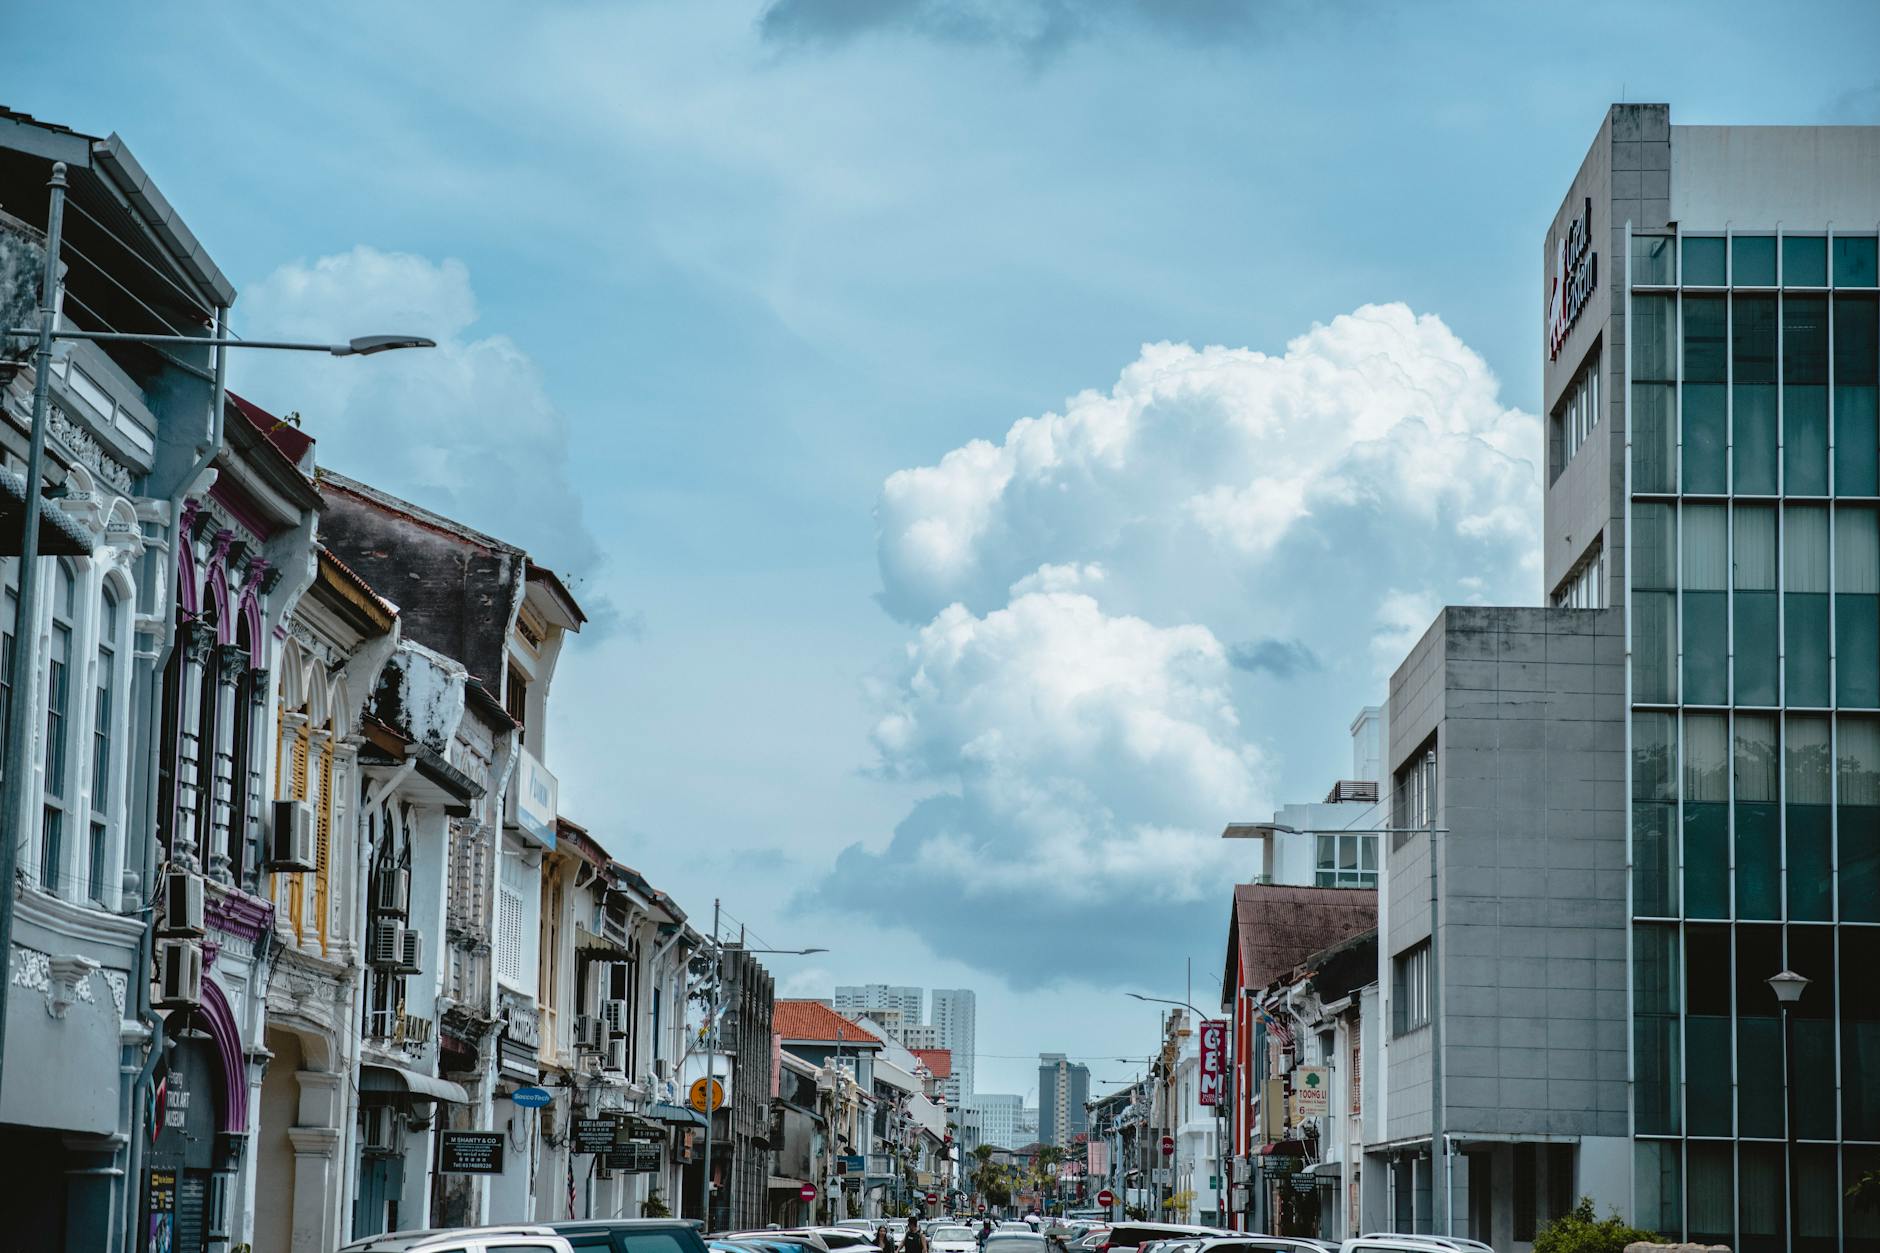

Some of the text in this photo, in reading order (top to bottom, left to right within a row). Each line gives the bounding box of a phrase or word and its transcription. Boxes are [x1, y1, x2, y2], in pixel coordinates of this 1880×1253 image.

[1566, 197, 1591, 273] Great
[1565, 251, 1597, 330] Eastern
[1201, 1028, 1224, 1094] GEM
[167, 1091, 190, 1108] TRICK ART
[1299, 1089, 1327, 1099] TOONG LI
[165, 1110, 185, 1127] MUSEUM
